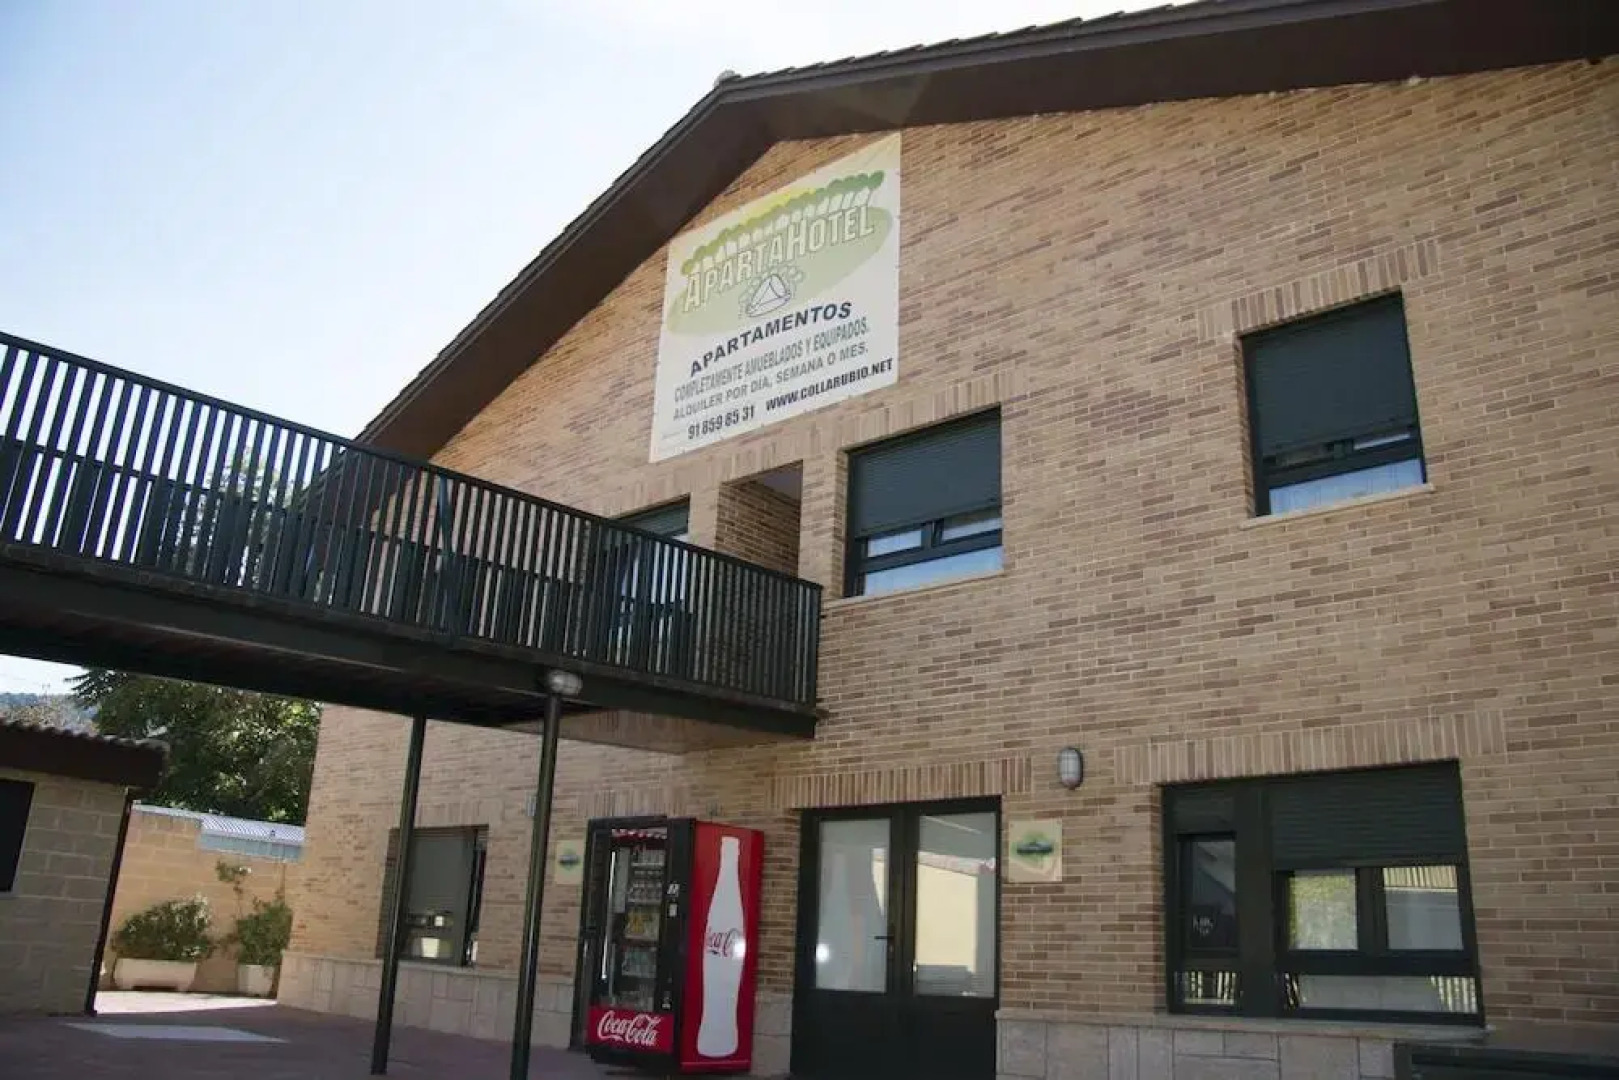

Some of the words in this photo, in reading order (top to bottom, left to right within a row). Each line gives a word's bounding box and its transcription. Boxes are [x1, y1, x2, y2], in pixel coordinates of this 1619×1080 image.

[674, 362, 743, 402] COMPLETAMENTE
[744, 340, 803, 377] AMUEBLADOS
[806, 337, 811, 355] Y
[690, 301, 852, 377] APARTAMENTOS
[673, 393, 723, 420] ALQUILER
[726, 384, 748, 402] POR
[776, 356, 823, 384] SEMANA
[827, 352, 836, 366] O
[687, 424, 700, 440] 91
[702, 415, 723, 435] 859
[742, 405, 755, 421] 31
[765, 357, 893, 412] WWW.COLLARUBIO.NET
